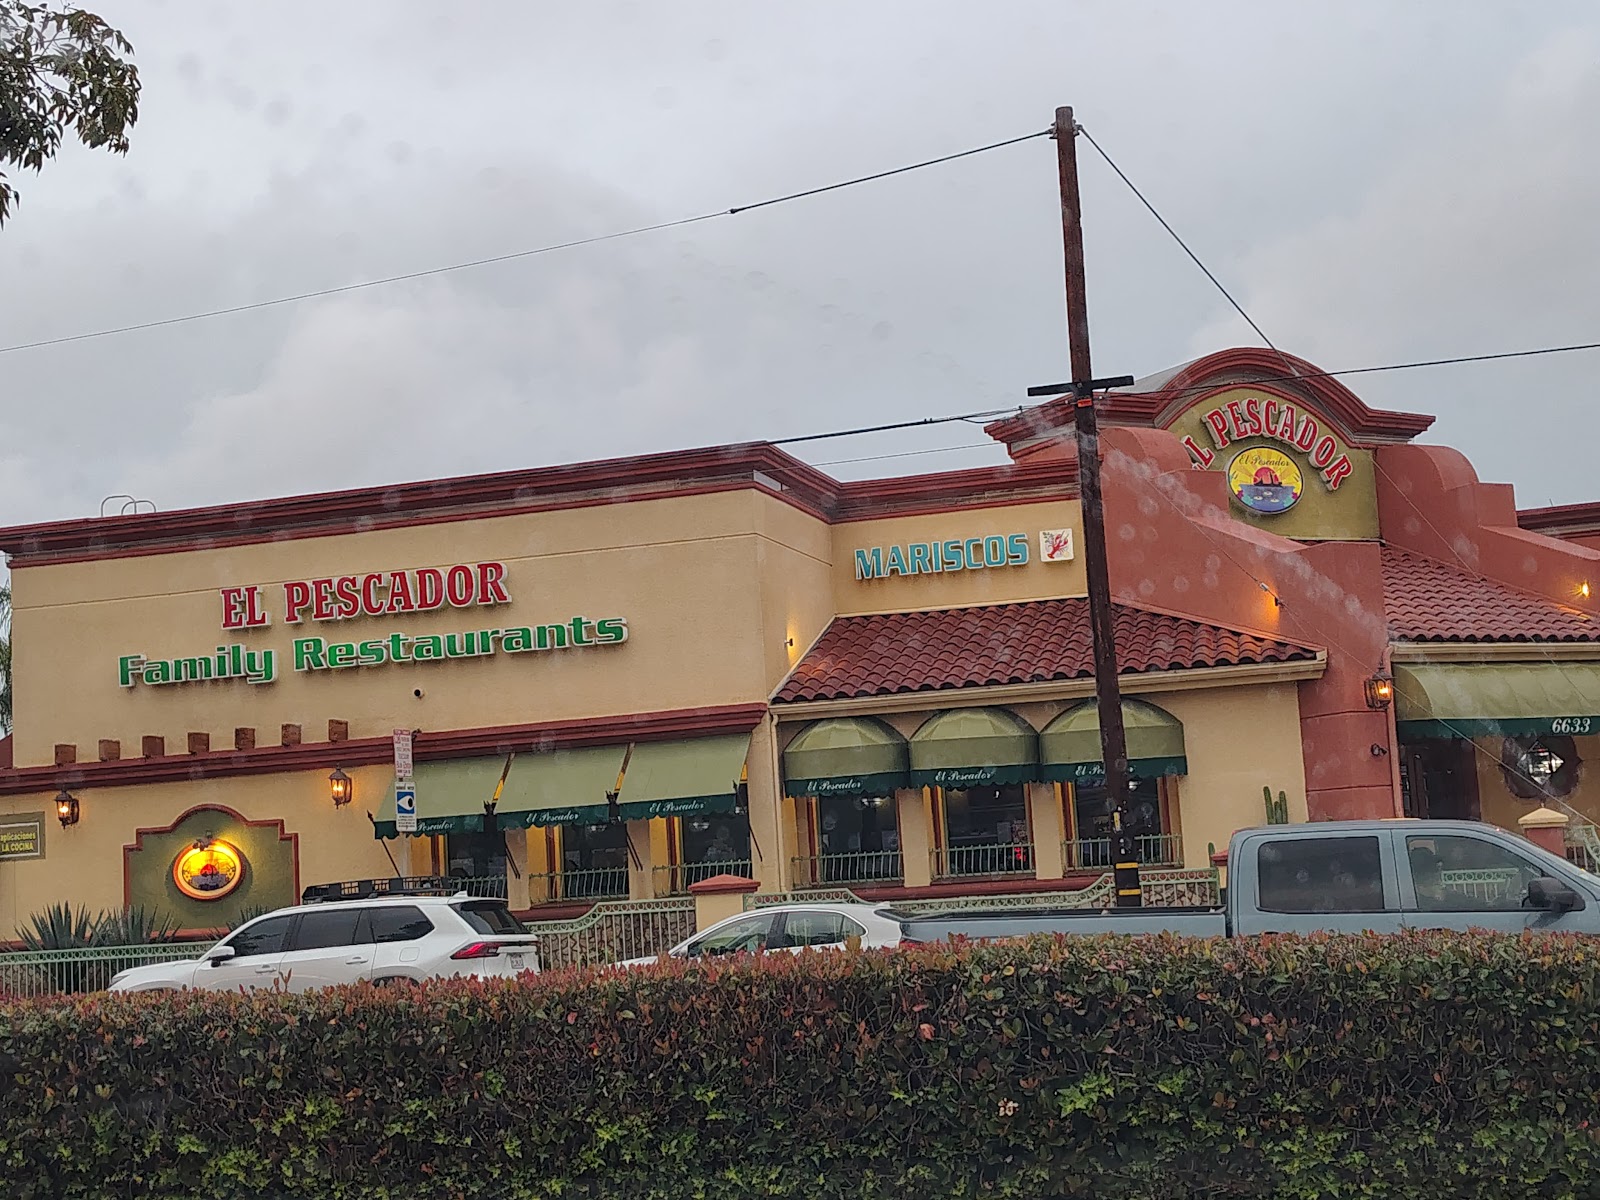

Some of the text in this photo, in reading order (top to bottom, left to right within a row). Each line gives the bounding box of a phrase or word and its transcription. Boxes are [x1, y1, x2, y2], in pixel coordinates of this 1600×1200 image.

[1182, 398, 1352, 491] L PESCADOR
[1238, 454, 1290, 467] El Pescador
[854, 532, 1029, 580] MARISCOS
[220, 562, 511, 629] EL PESCADOR
[118, 615, 628, 686] Family Restaurants
[1552, 717, 1591, 734] 6633
[936, 768, 991, 782] El Pescador
[1075, 765, 1087, 776] El
[807, 779, 862, 792] El Pescador
[650, 799, 704, 812] El Pescador
[526, 811, 579, 823] El Pescador
[11, 842, 34, 851] COCINA
